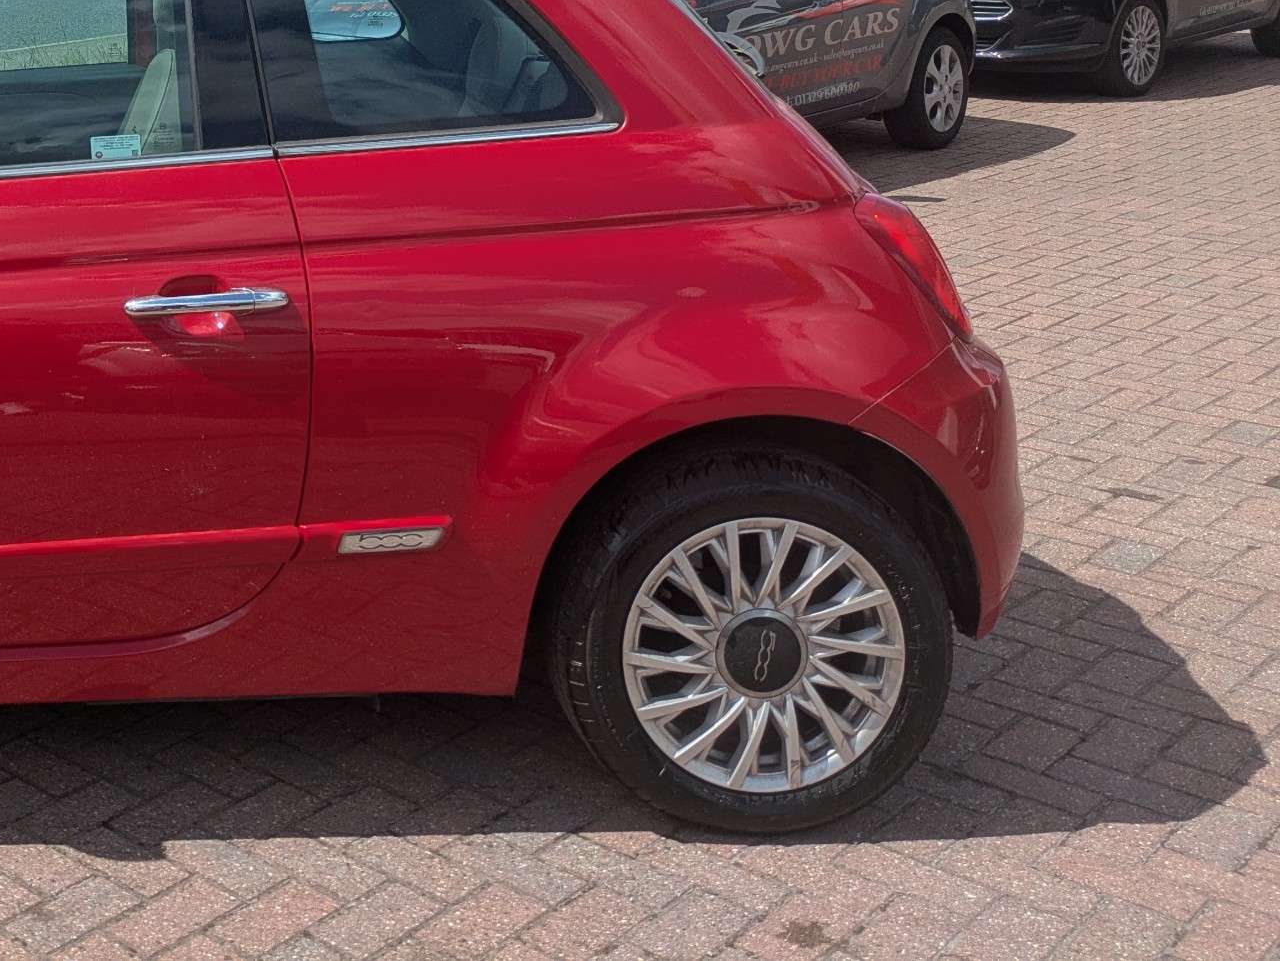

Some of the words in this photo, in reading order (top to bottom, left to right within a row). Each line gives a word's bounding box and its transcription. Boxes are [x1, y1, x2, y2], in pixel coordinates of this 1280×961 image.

[824, 7, 901, 46] CARS
[359, 533, 423, 550] 500
[754, 628, 777, 681] 500
